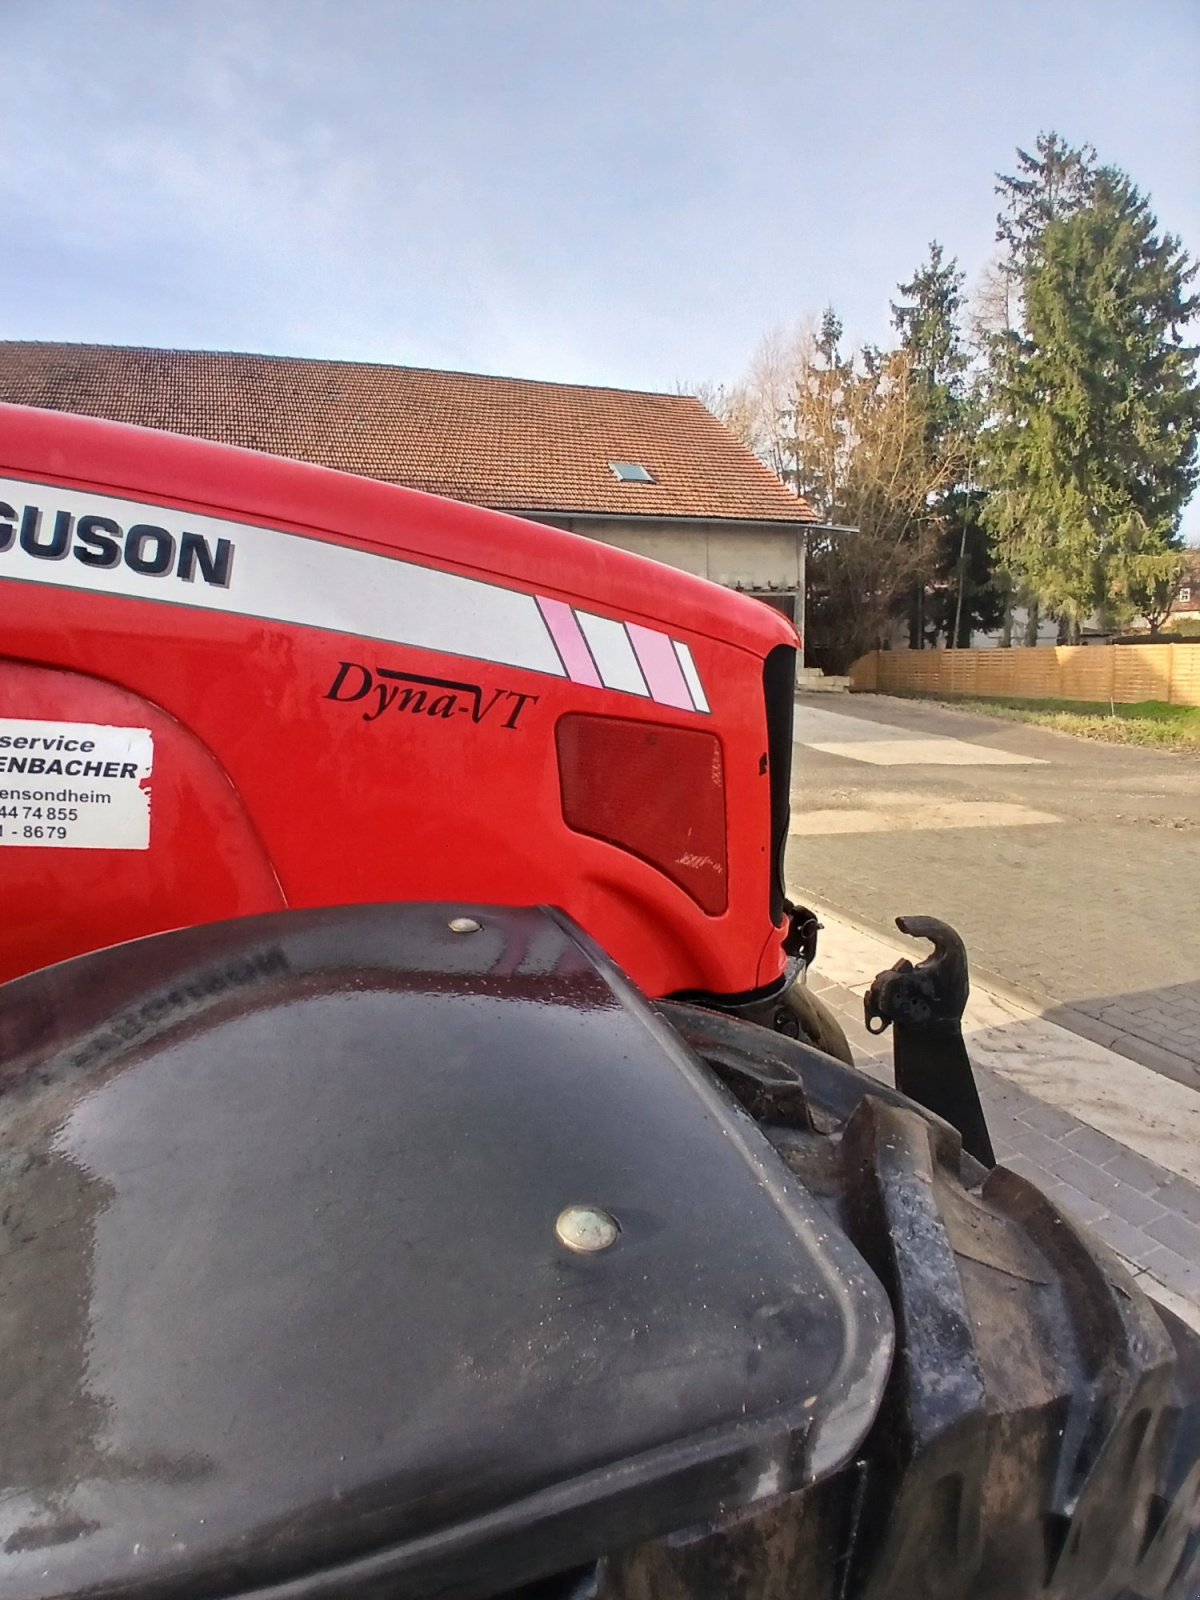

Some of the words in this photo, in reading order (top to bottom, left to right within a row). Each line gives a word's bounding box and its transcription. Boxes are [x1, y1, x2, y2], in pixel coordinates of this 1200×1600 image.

[322, 661, 539, 730] Dyna-VT
[0, 735, 95, 752] service
[0, 789, 111, 804] ensondheim
